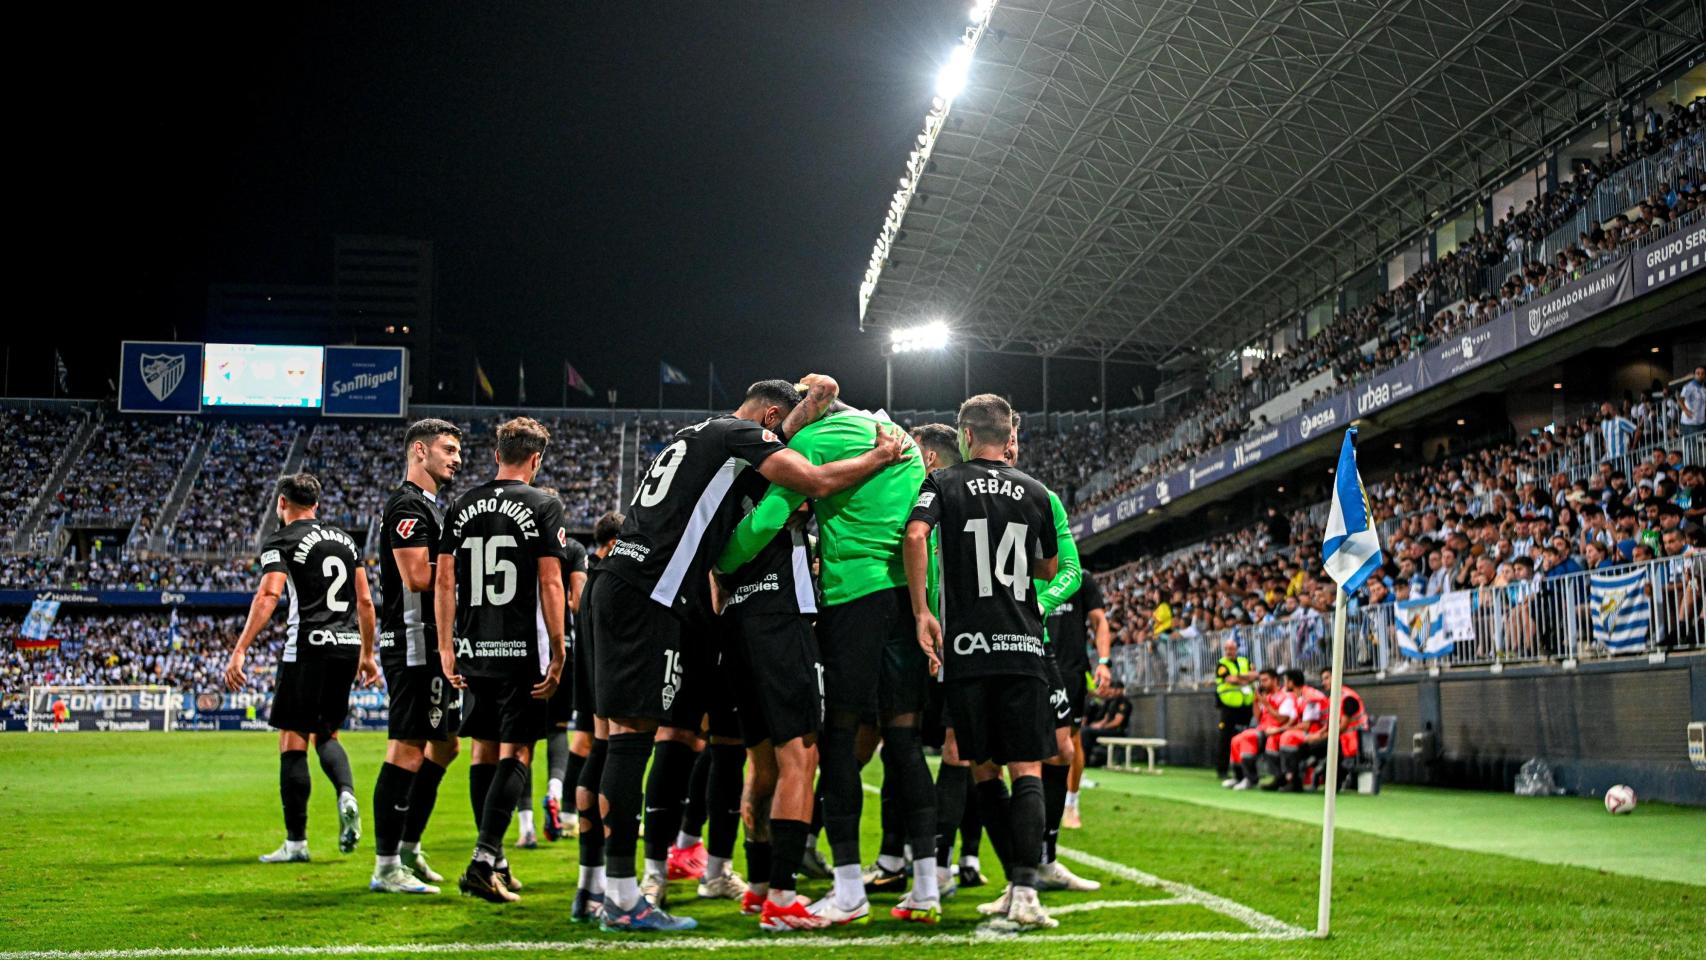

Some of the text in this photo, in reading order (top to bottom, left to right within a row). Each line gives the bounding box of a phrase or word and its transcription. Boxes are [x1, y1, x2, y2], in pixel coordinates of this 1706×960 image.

[1646, 239, 1683, 268] GRUPO
[1311, 407, 1337, 428] BOSA
[966, 478, 1025, 501] FEBAS
[498, 499, 540, 541] NÚÑEZ
[293, 530, 322, 565] MARIO
[963, 518, 1031, 602] 14
[322, 556, 349, 612] 2
[461, 535, 518, 607] 15
[475, 639, 527, 649] cerramientos
[475, 648, 527, 657] abatibles
[991, 633, 1042, 647] cerramiento
[992, 641, 1045, 657] abatibl
[139, 691, 184, 711] SUR
[430, 676, 443, 705] 9
